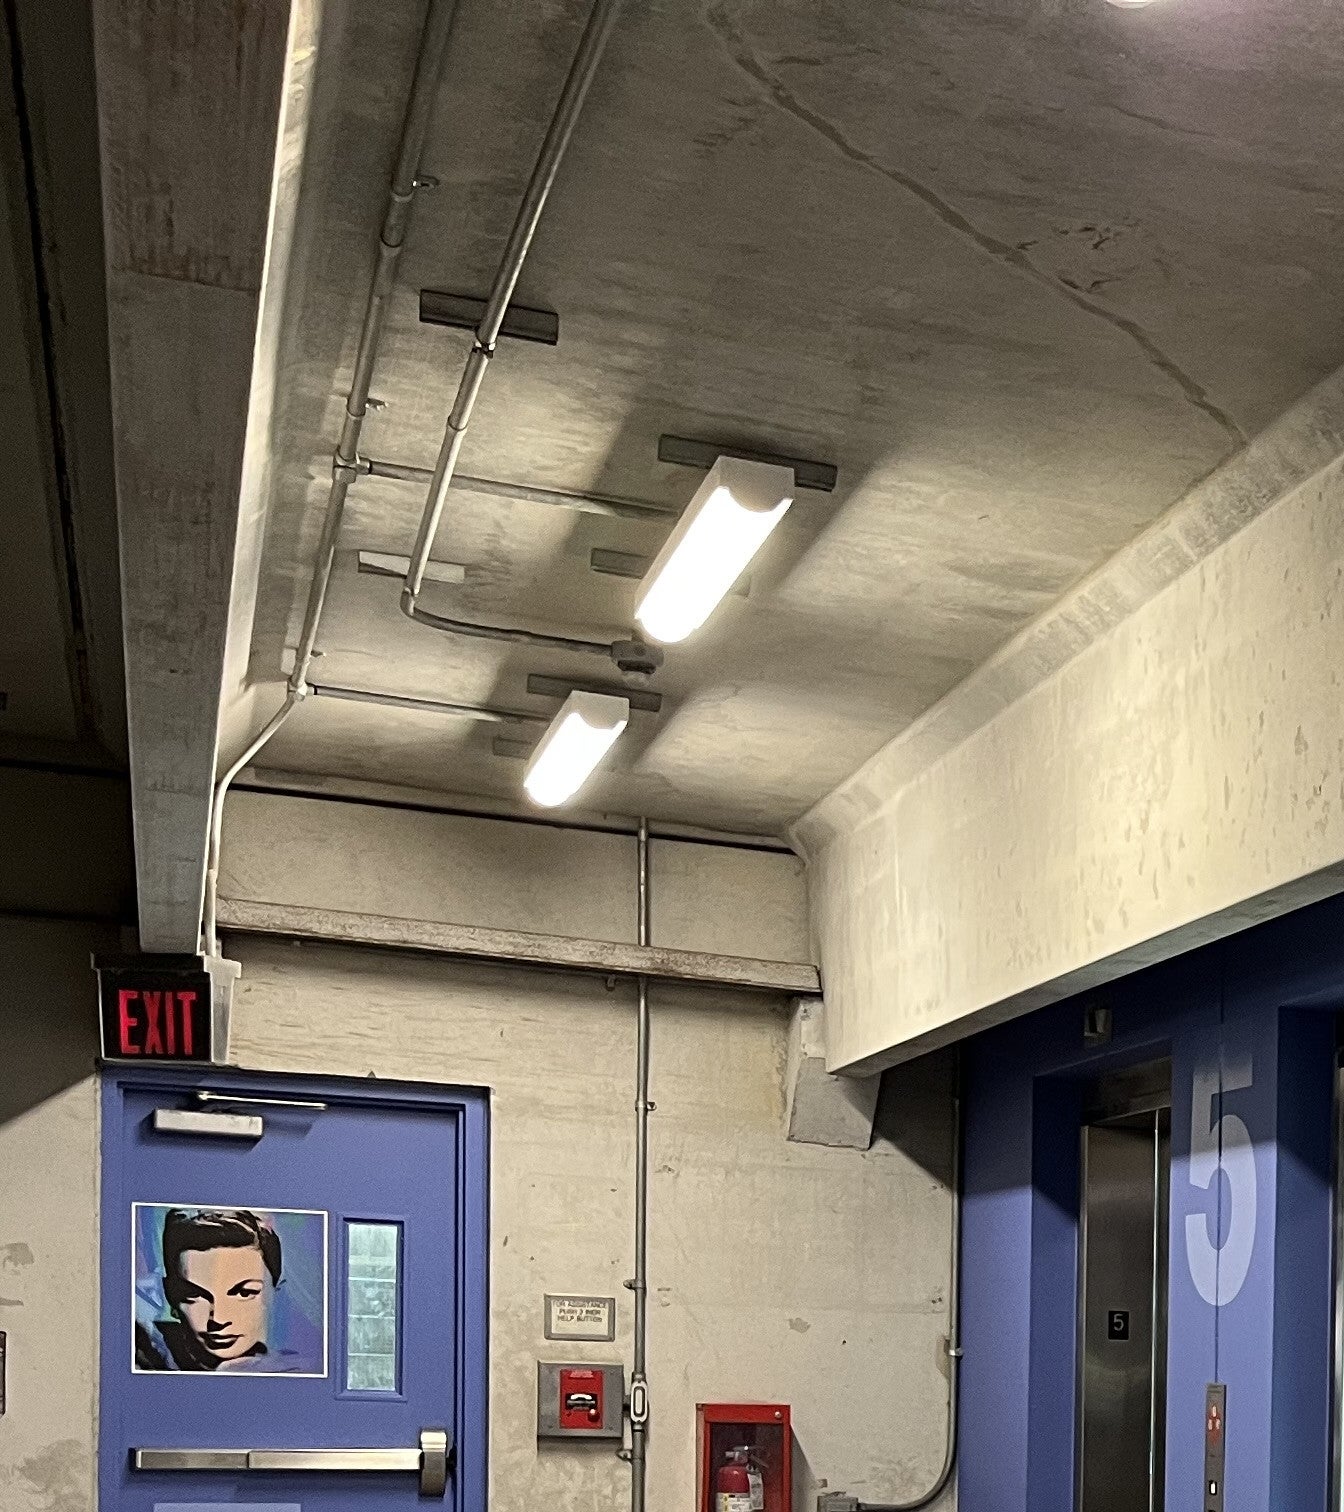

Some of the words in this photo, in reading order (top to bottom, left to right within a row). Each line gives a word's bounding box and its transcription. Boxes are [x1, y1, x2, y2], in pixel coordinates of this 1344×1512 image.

[118, 989, 197, 1055] EXIT
[1185, 1047, 1257, 1307] 5
[1113, 1313, 1124, 1331] 5
